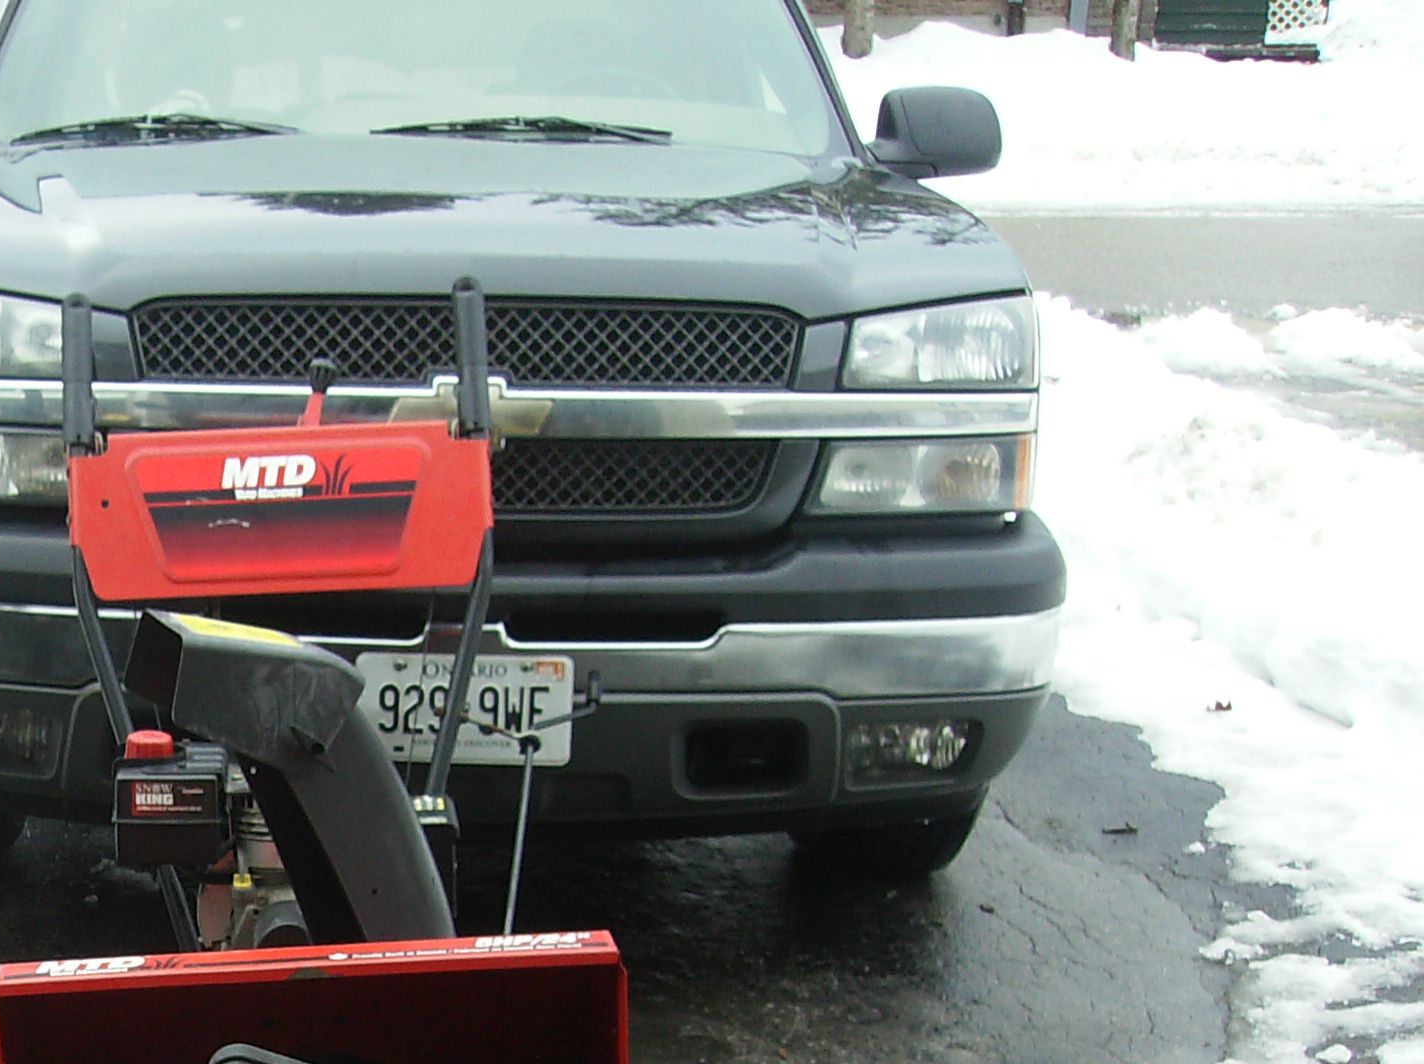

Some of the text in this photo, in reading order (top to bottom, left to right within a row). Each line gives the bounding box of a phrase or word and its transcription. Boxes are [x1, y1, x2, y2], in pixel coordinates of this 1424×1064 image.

[221, 454, 316, 490] MTD
[136, 783, 173, 793] SNOW
[136, 793, 174, 805] KING
[35, 956, 145, 975] MTD
